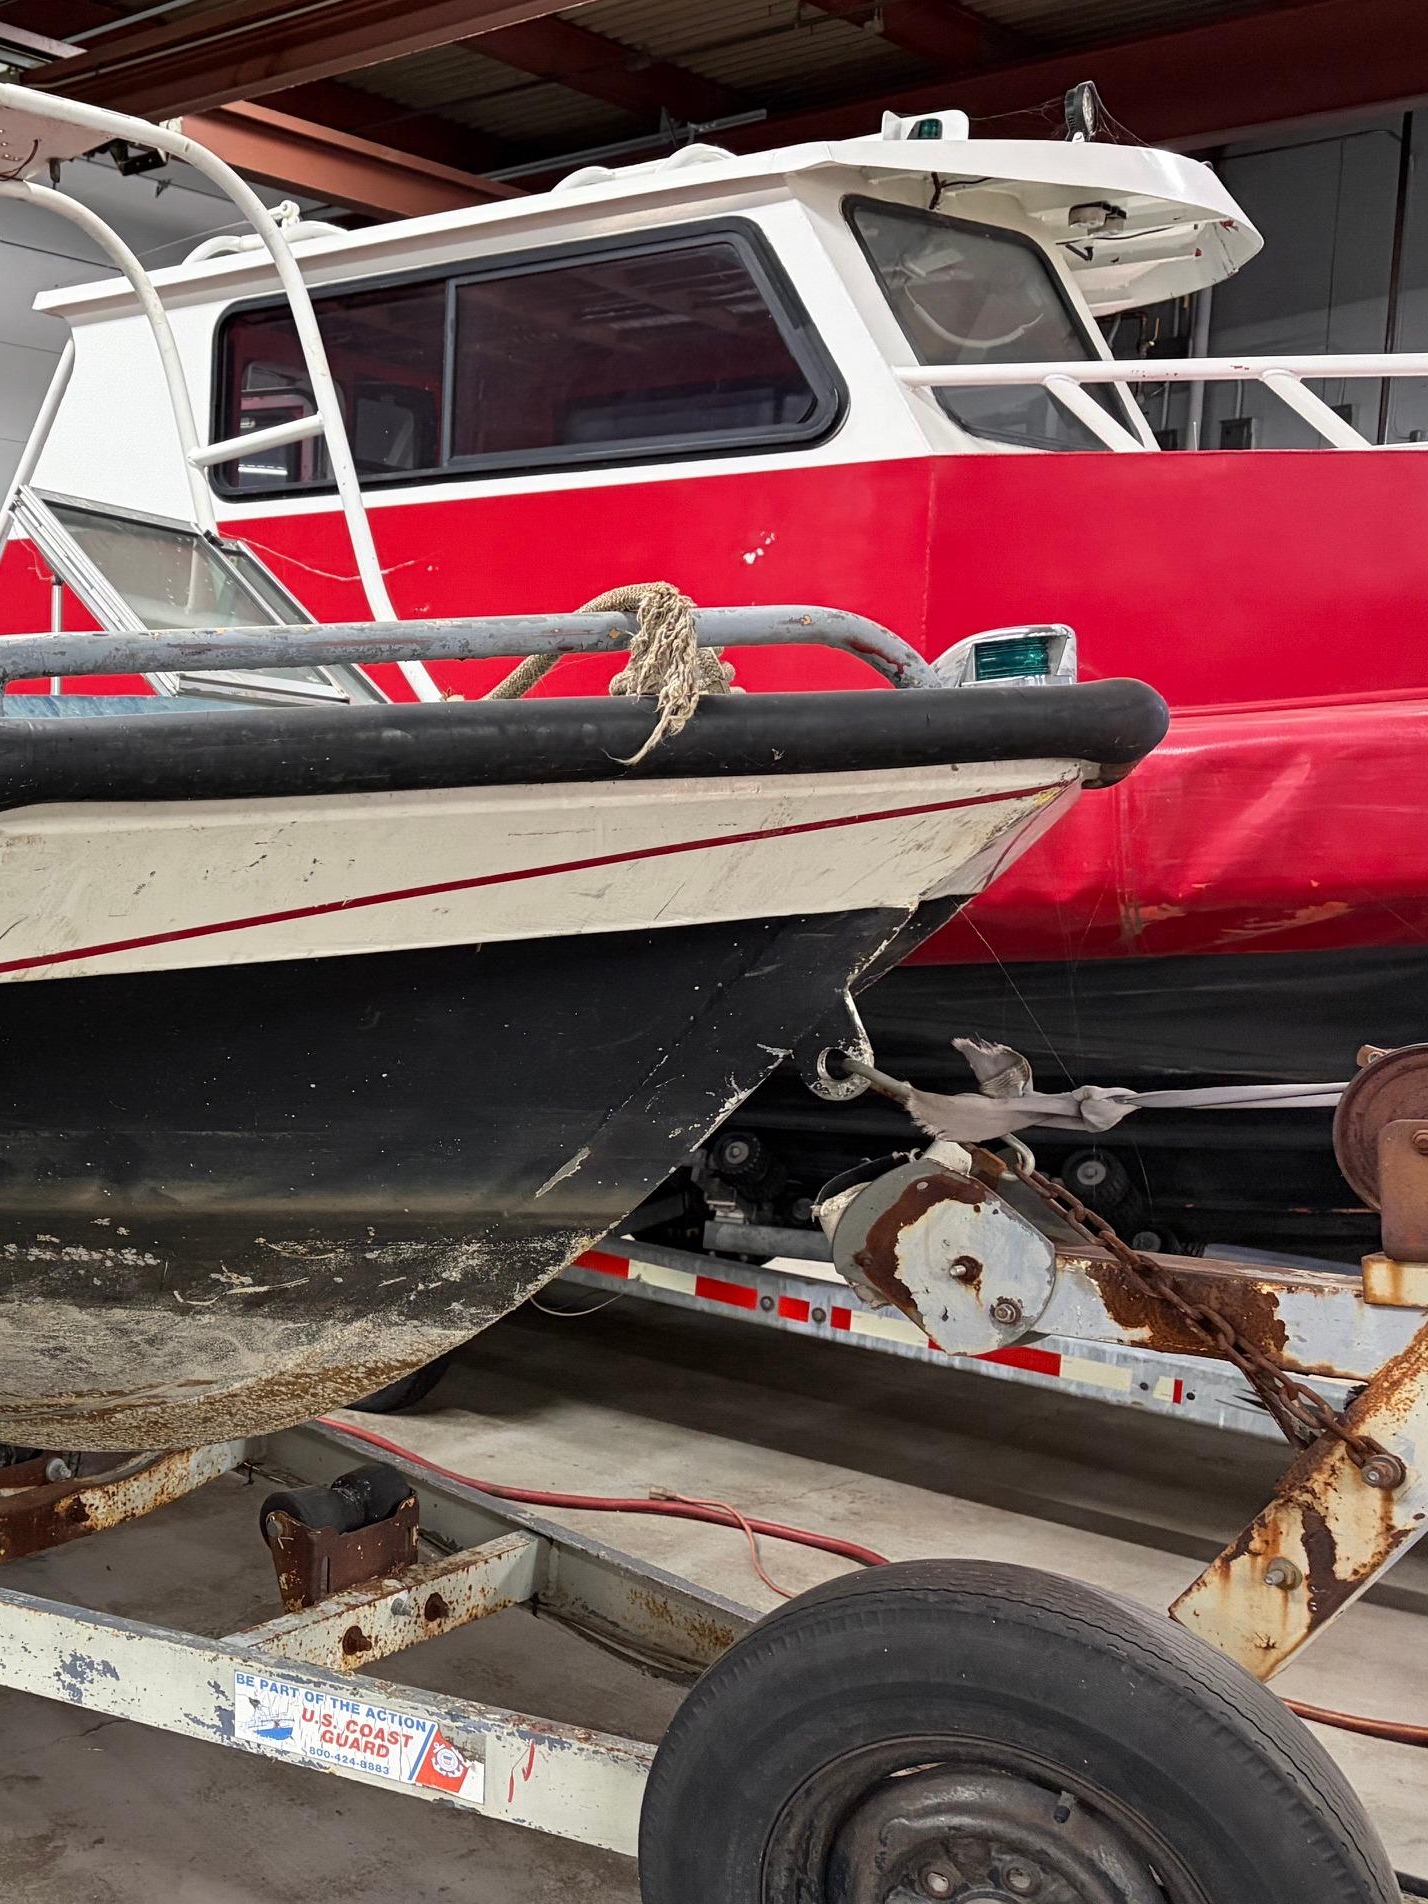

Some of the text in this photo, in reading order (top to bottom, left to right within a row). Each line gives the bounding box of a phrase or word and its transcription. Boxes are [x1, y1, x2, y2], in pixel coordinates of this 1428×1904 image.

[236, 1673, 426, 1732] BE PART OF THE ACTION
[302, 1707, 413, 1748] U.S. COAST
[321, 1729, 390, 1758] GUARD
